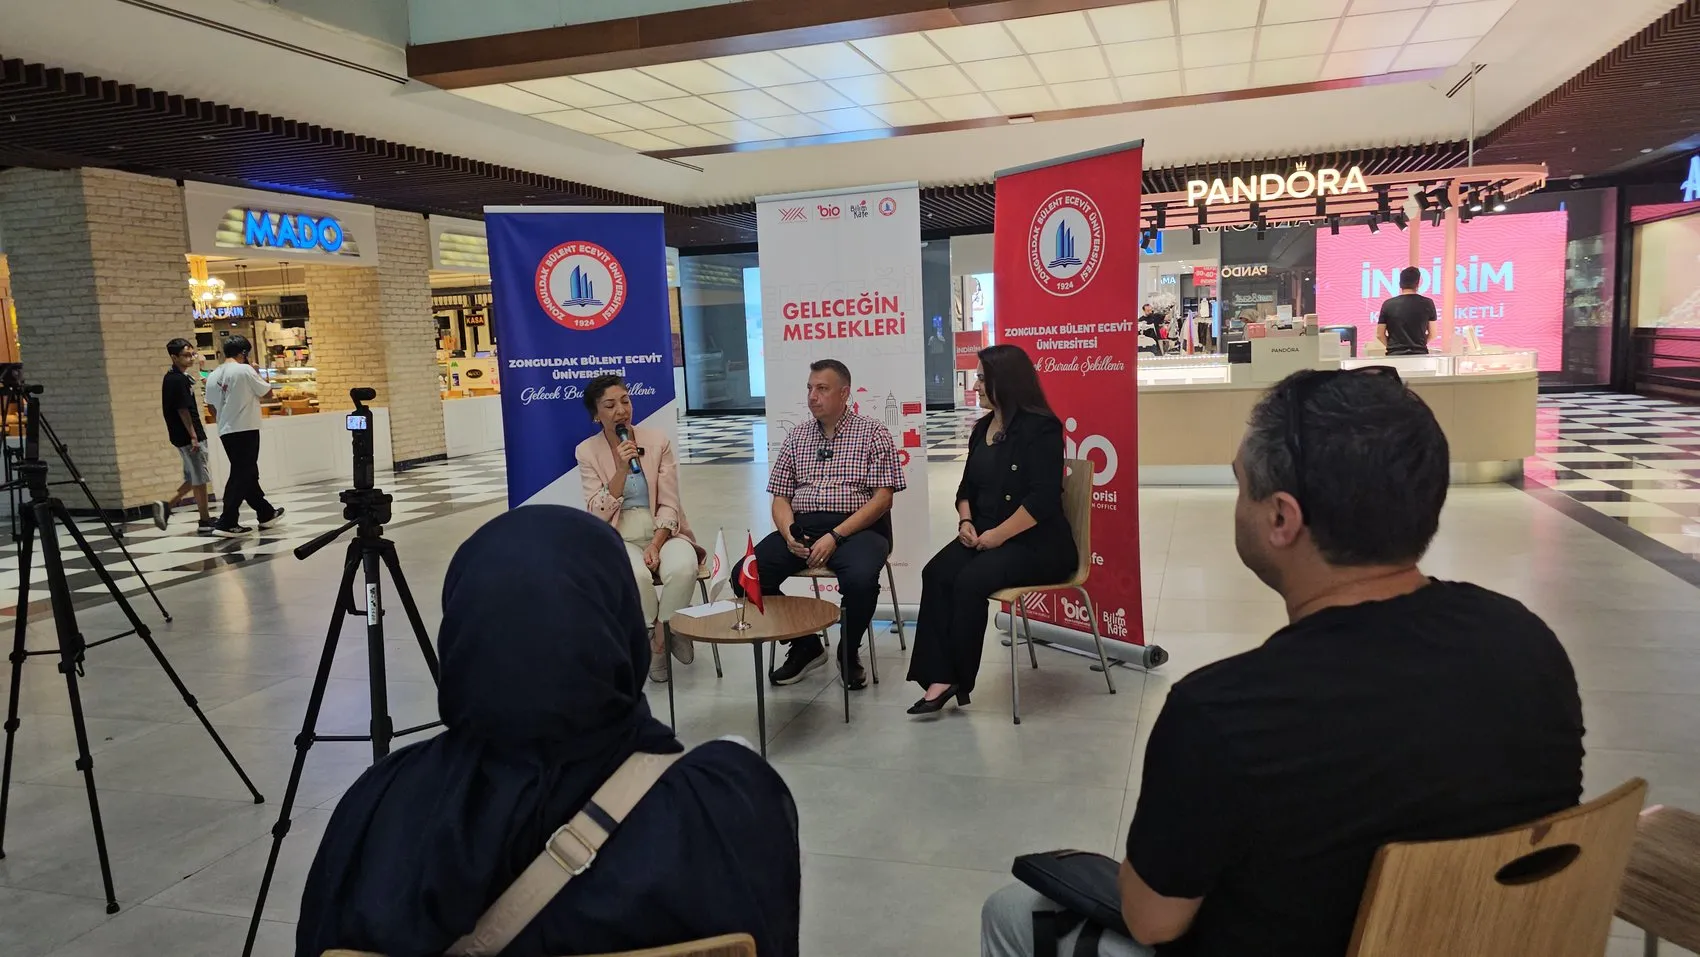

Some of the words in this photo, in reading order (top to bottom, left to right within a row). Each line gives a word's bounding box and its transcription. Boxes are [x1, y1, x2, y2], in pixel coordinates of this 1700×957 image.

[1187, 164, 1368, 207] PANDORA
[1037, 197, 1063, 225] BÜLENT
[1065, 196, 1091, 213] ECEVİT
[245, 209, 343, 252] MADO
[545, 245, 576, 267] BÜLENT
[579, 245, 610, 263] ECEVİT
[1031, 226, 1051, 284] ZONGULDAK
[1080, 212, 1101, 282] ÜNİVERSİTESİ
[539, 267, 566, 320] ZONGULDAK
[602, 262, 623, 320] ÜNİVERSİTESİ
[1056, 281, 1074, 290] 1924
[783, 291, 899, 320] GELECEĞİN
[466, 316, 484, 324] KASA
[574, 319, 595, 327] 1924
[783, 312, 906, 341] MESLEKLERİ
[1004, 325, 1058, 337] ZONGULDAK
[1060, 323, 1096, 334] BÜLENT
[1098, 319, 1133, 333] ECEVİT
[1036, 336, 1098, 350] ÜNİVERSİTESİ
[508, 357, 578, 368] ZONGULDAK
[580, 354, 623, 366] BÜLENT
[625, 352, 662, 364] ECEVİT
[1043, 356, 1080, 373] Burada
[1080, 355, 1125, 377] Şekillenir
[552, 367, 626, 380] ÜNİVERSİTESİ
[520, 386, 561, 405] Gelecek
[1097, 503, 1117, 511] OFFICE
[1091, 552, 1104, 565] fe
[1103, 610, 1126, 626] Bilim
[1107, 620, 1128, 637] Kafe
